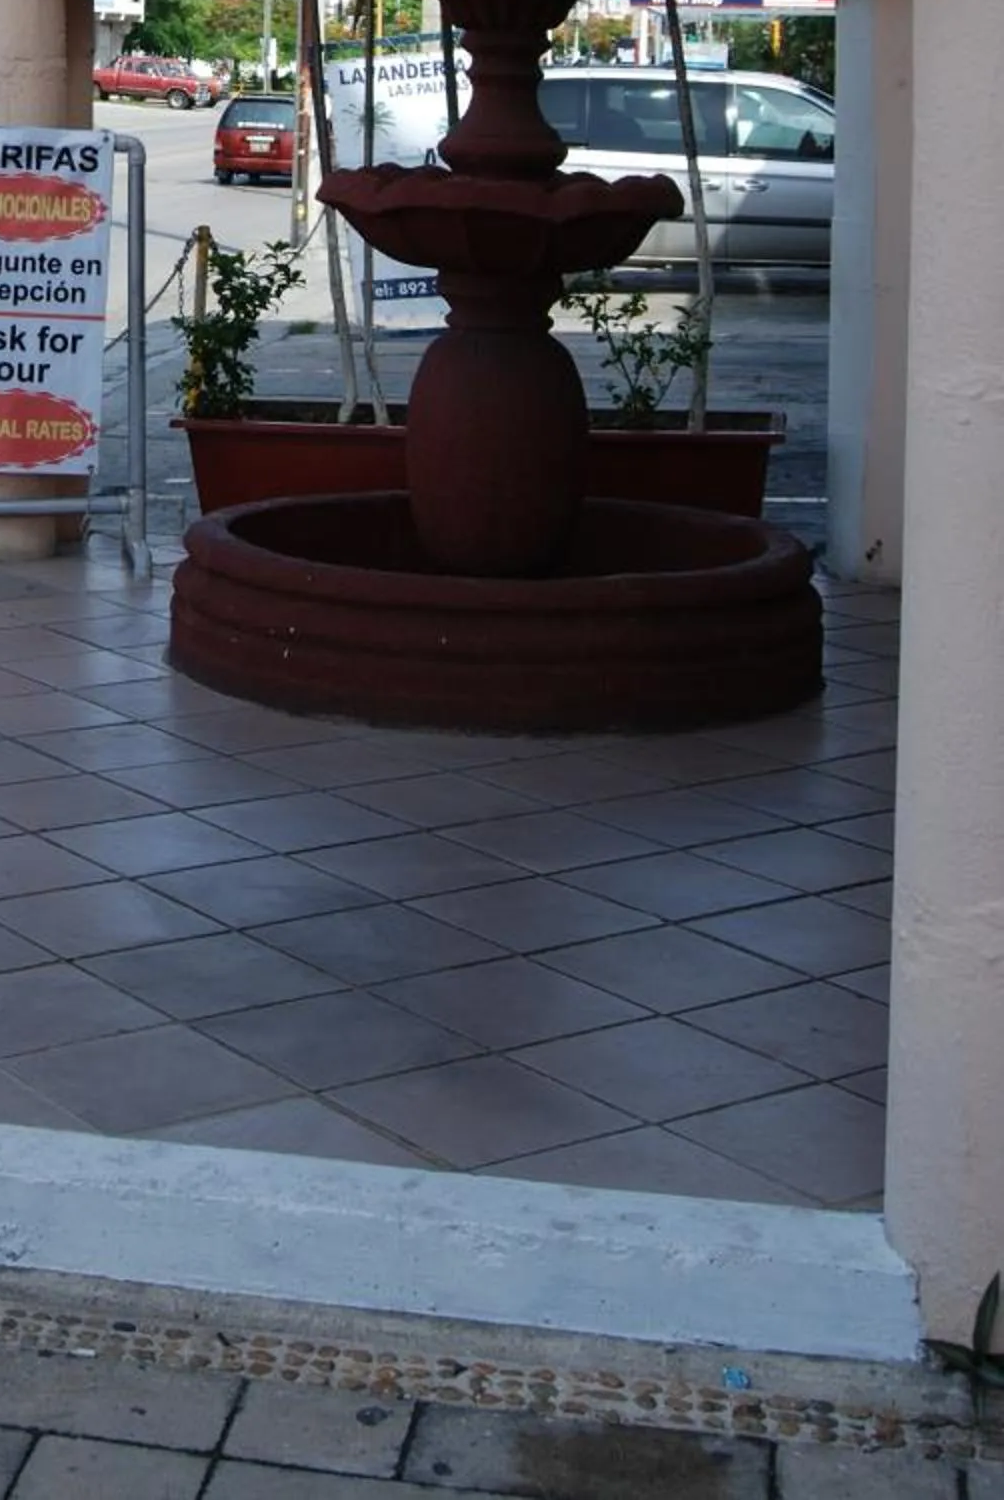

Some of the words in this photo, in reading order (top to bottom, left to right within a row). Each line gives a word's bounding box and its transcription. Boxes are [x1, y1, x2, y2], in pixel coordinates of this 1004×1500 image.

[339, 57, 465, 85] LAANDERA
[388, 84, 413, 98] LAS
[70, 256, 102, 276] en
[370, 281, 394, 298] el:
[398, 281, 428, 295] 892
[37, 325, 84, 354] for
[25, 419, 84, 443] RATES
